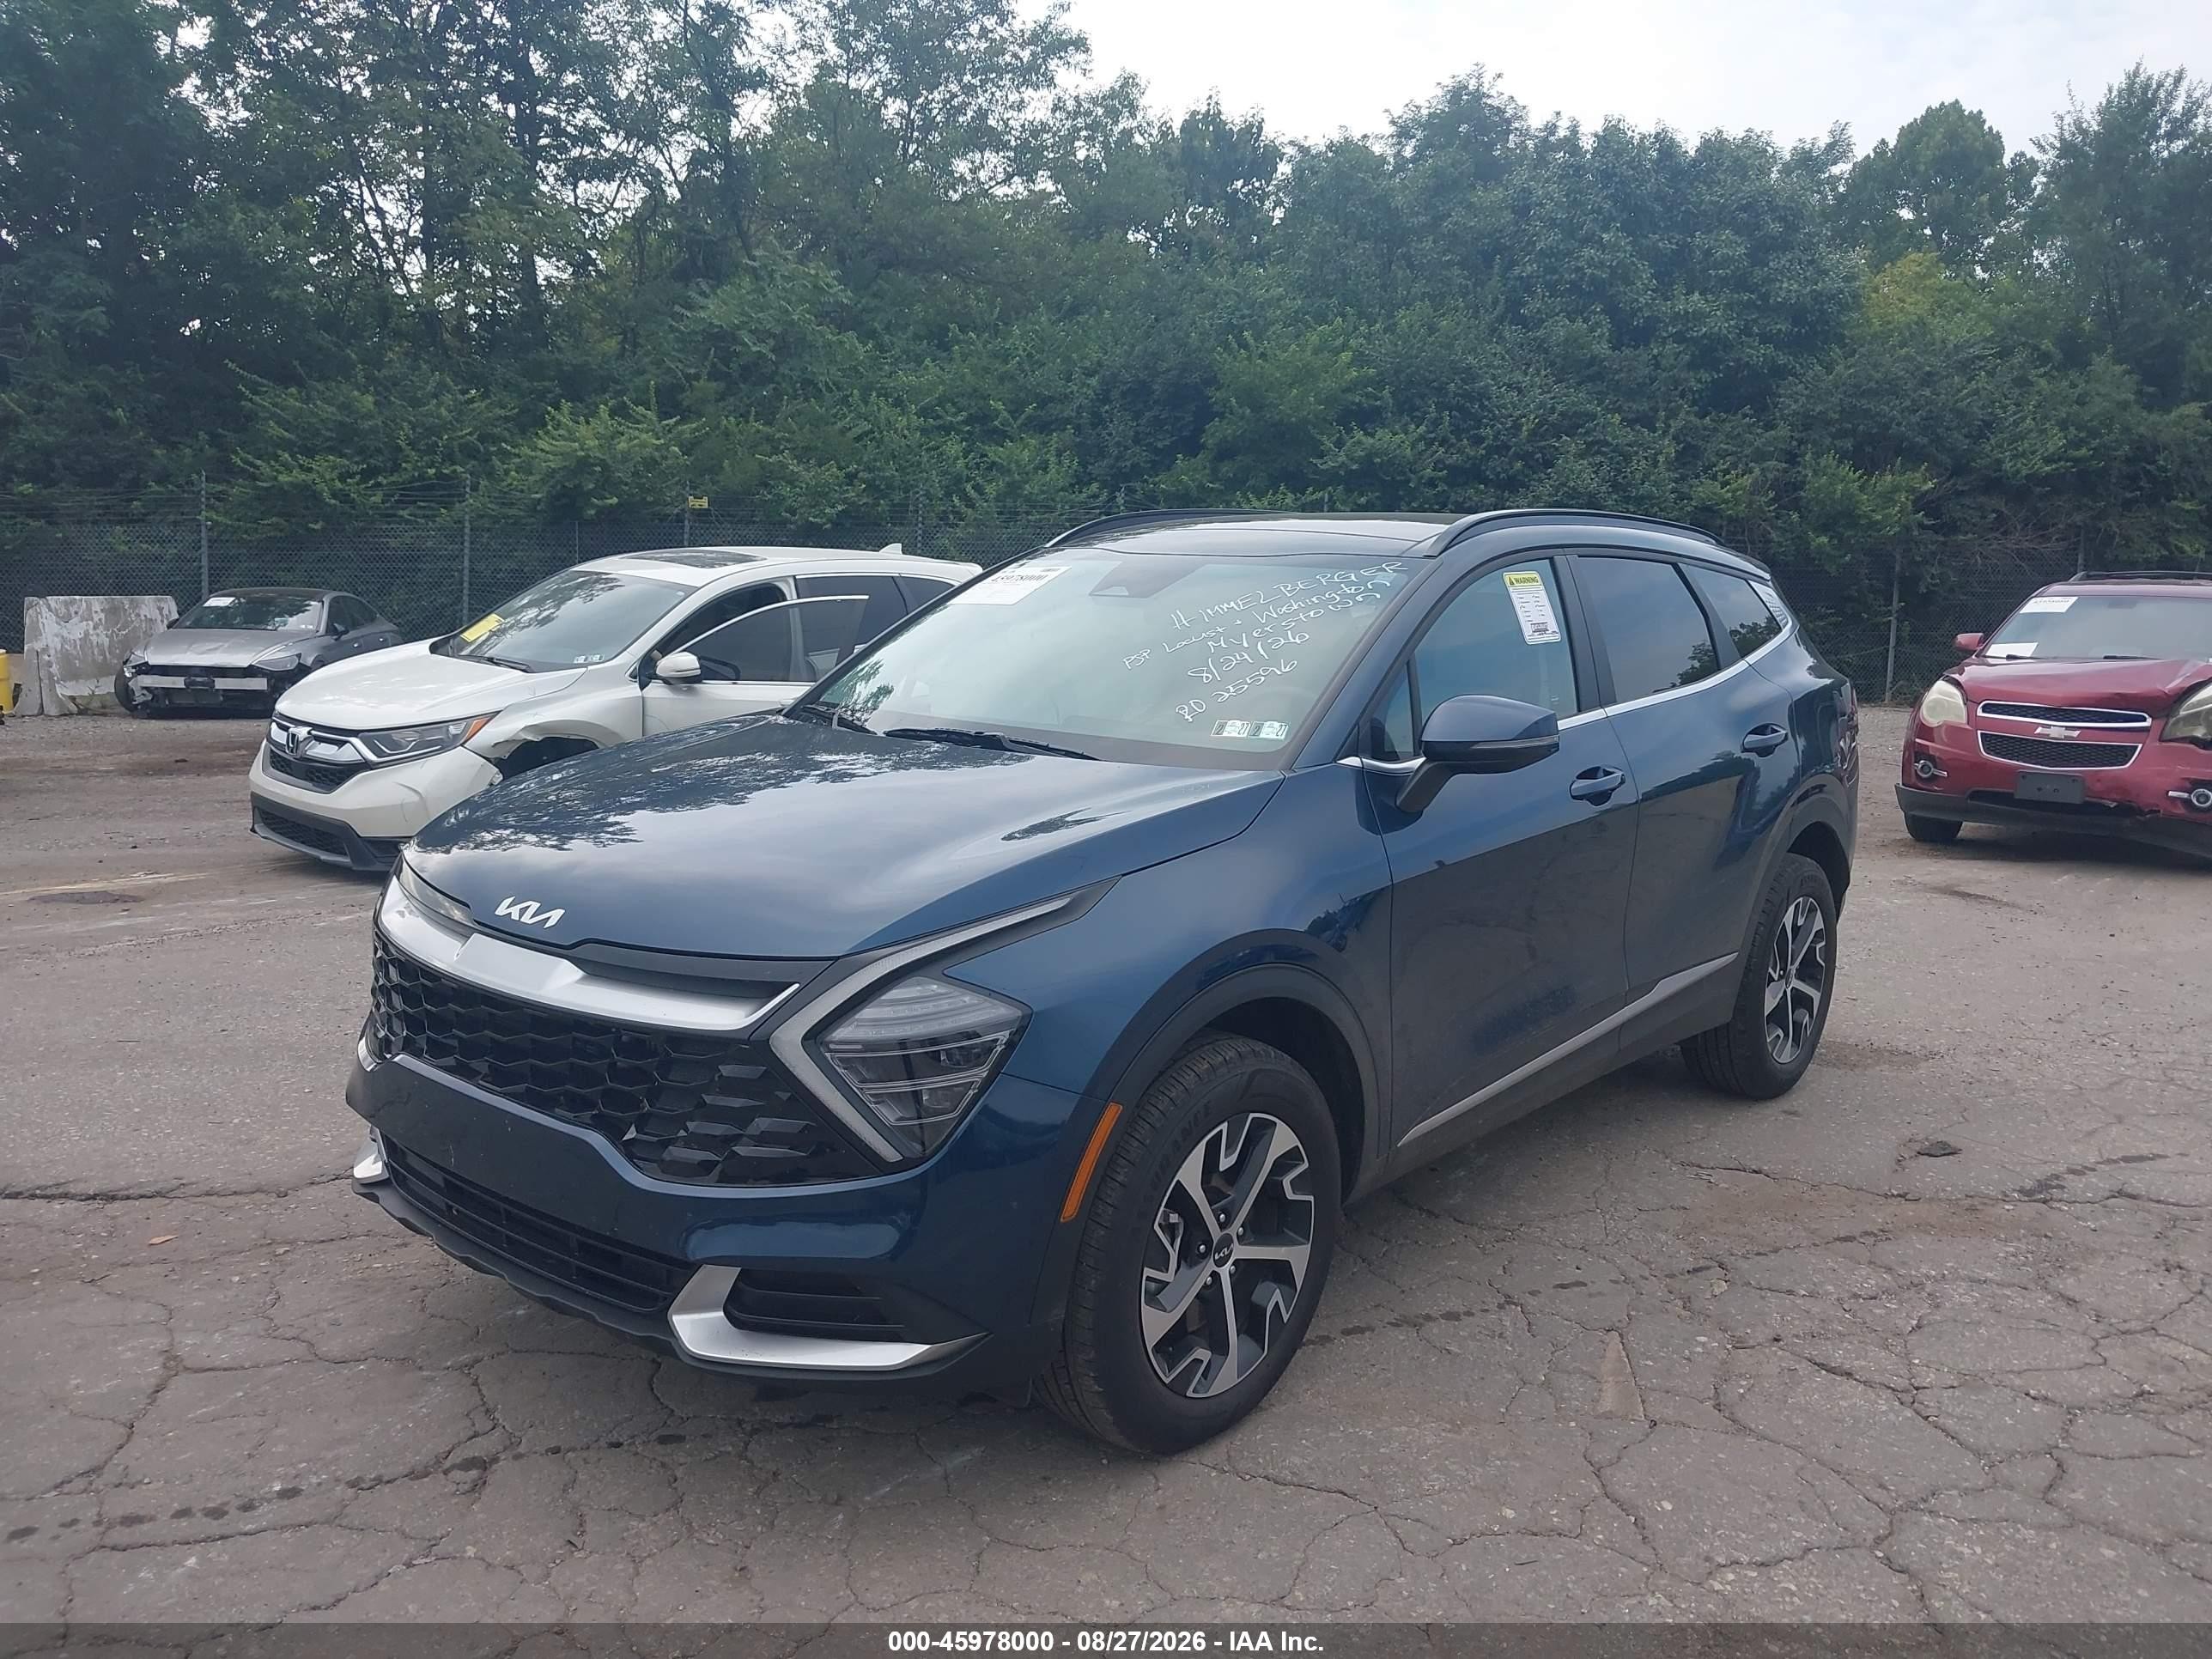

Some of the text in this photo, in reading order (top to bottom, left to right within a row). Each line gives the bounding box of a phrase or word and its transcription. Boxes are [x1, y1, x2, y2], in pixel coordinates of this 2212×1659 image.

[1513, 575, 1539, 585] WARNING
[1162, 626, 1227, 653] Locust
[1251, 580, 1390, 623] Washington
[495, 896, 566, 929] KIA
